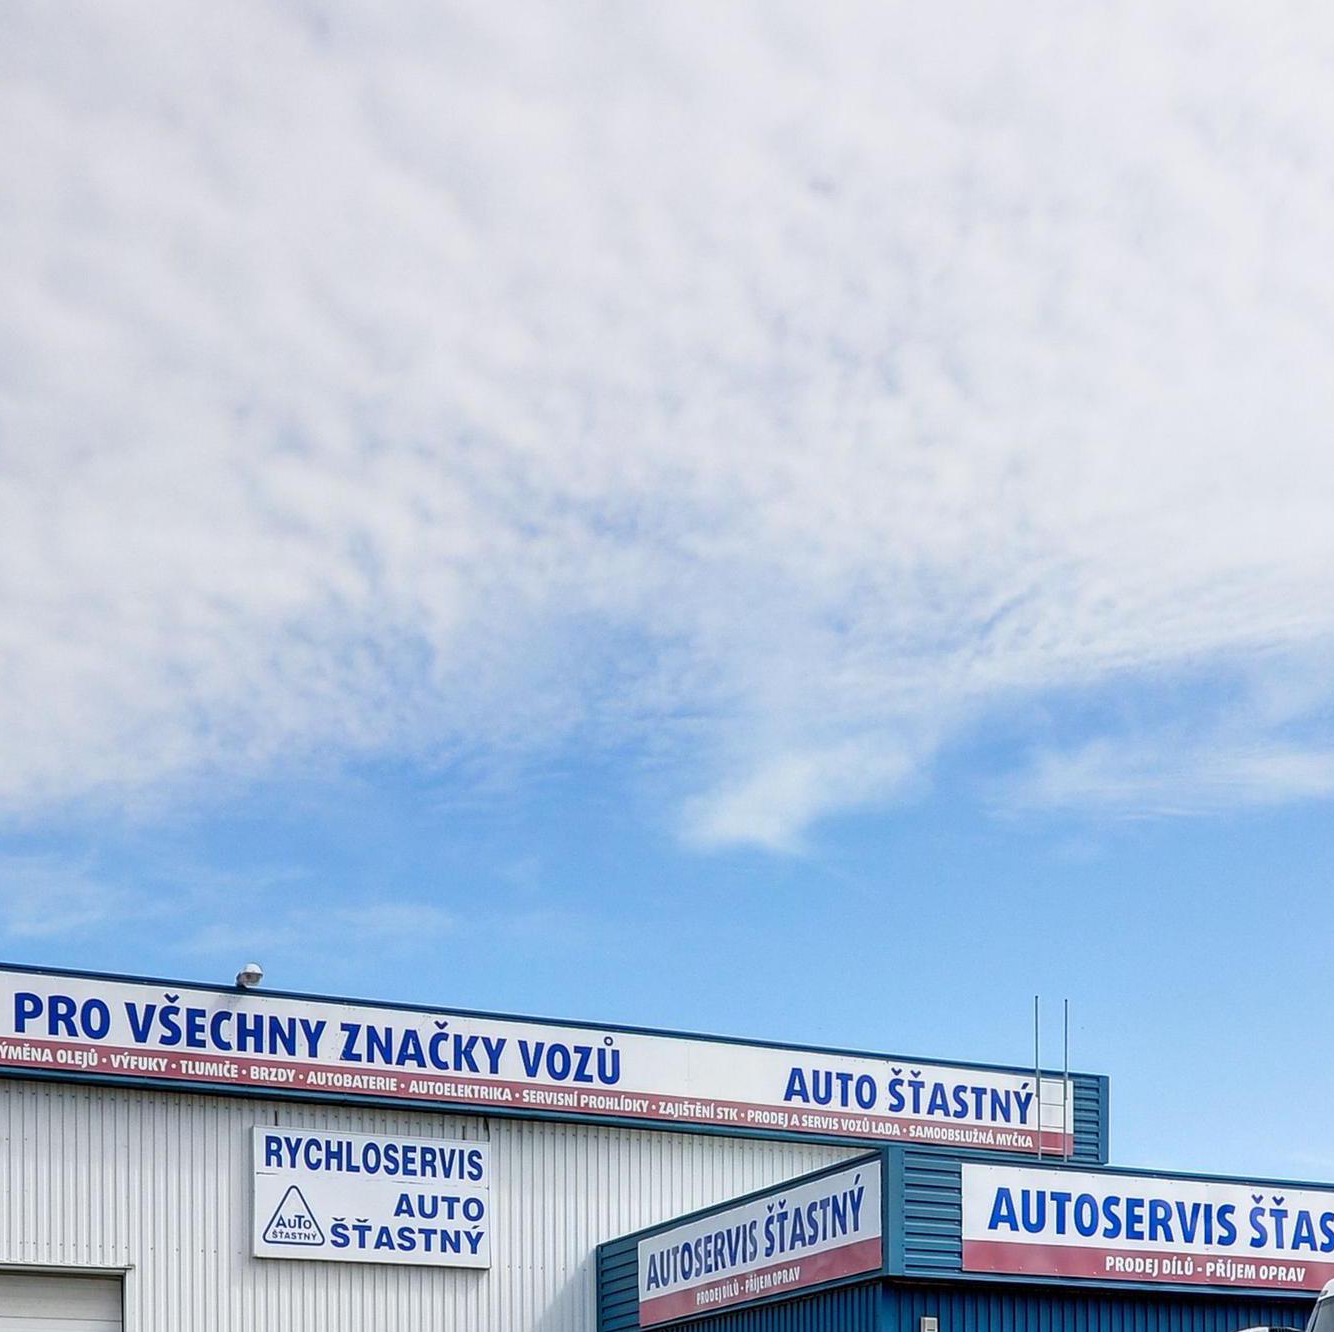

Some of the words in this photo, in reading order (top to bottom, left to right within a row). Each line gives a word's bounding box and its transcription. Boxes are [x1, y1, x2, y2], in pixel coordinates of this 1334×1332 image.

[14, 992, 111, 1040] PRO
[125, 993, 327, 1058] VŠECHNY
[339, 1020, 507, 1075] ZNAČKY
[518, 1036, 620, 1085] VOZŮ
[57, 1047, 98, 1066] OLEJŮ
[110, 1052, 168, 1072] VÝFUKY
[179, 1060, 239, 1079] TLUMIČE
[250, 1066, 296, 1083] BRZDY
[306, 1070, 397, 1091] AUTOBATERIE
[408, 1079, 512, 1101] AUTOELEKTRIKA
[522, 1088, 579, 1107] SERVISNÍ
[579, 1094, 649, 1113] PROHLÍDKY
[658, 1099, 715, 1119] ZAJIŠTĚNÍ
[716, 1107, 738, 1121] STK
[747, 1109, 789, 1127] PRODEJ
[790, 1114, 800, 1127] A
[802, 1115, 839, 1130] SERVIS
[841, 1116, 869, 1133] VOZŮ
[872, 1121, 900, 1136] LADA
[909, 1125, 994, 1145] SAMOOBSLUŽNÁ
[996, 1132, 1033, 1148] MYČKA
[783, 1067, 877, 1109] AUTO
[888, 1067, 1034, 1125] ŠŤASTNÝ
[265, 1135, 483, 1181] RYCHLOSERVIS
[393, 1193, 485, 1222] AUTO
[988, 1187, 1237, 1245] AUTOSERVIS
[271, 1229, 317, 1241] ŠŤASTNÝ
[330, 1217, 485, 1255] ŠŤASTNÝ
[646, 1219, 758, 1292] AUTOSERVIS
[764, 1174, 865, 1258] ŠŤASTNÝ
[772, 1266, 801, 1286] OPRAV
[1106, 1255, 1158, 1276] PRODEJ
[1162, 1255, 1194, 1276] DÍLŮ
[1205, 1259, 1256, 1281] PŘÍJEM
[1259, 1265, 1305, 1283] OPRAV
